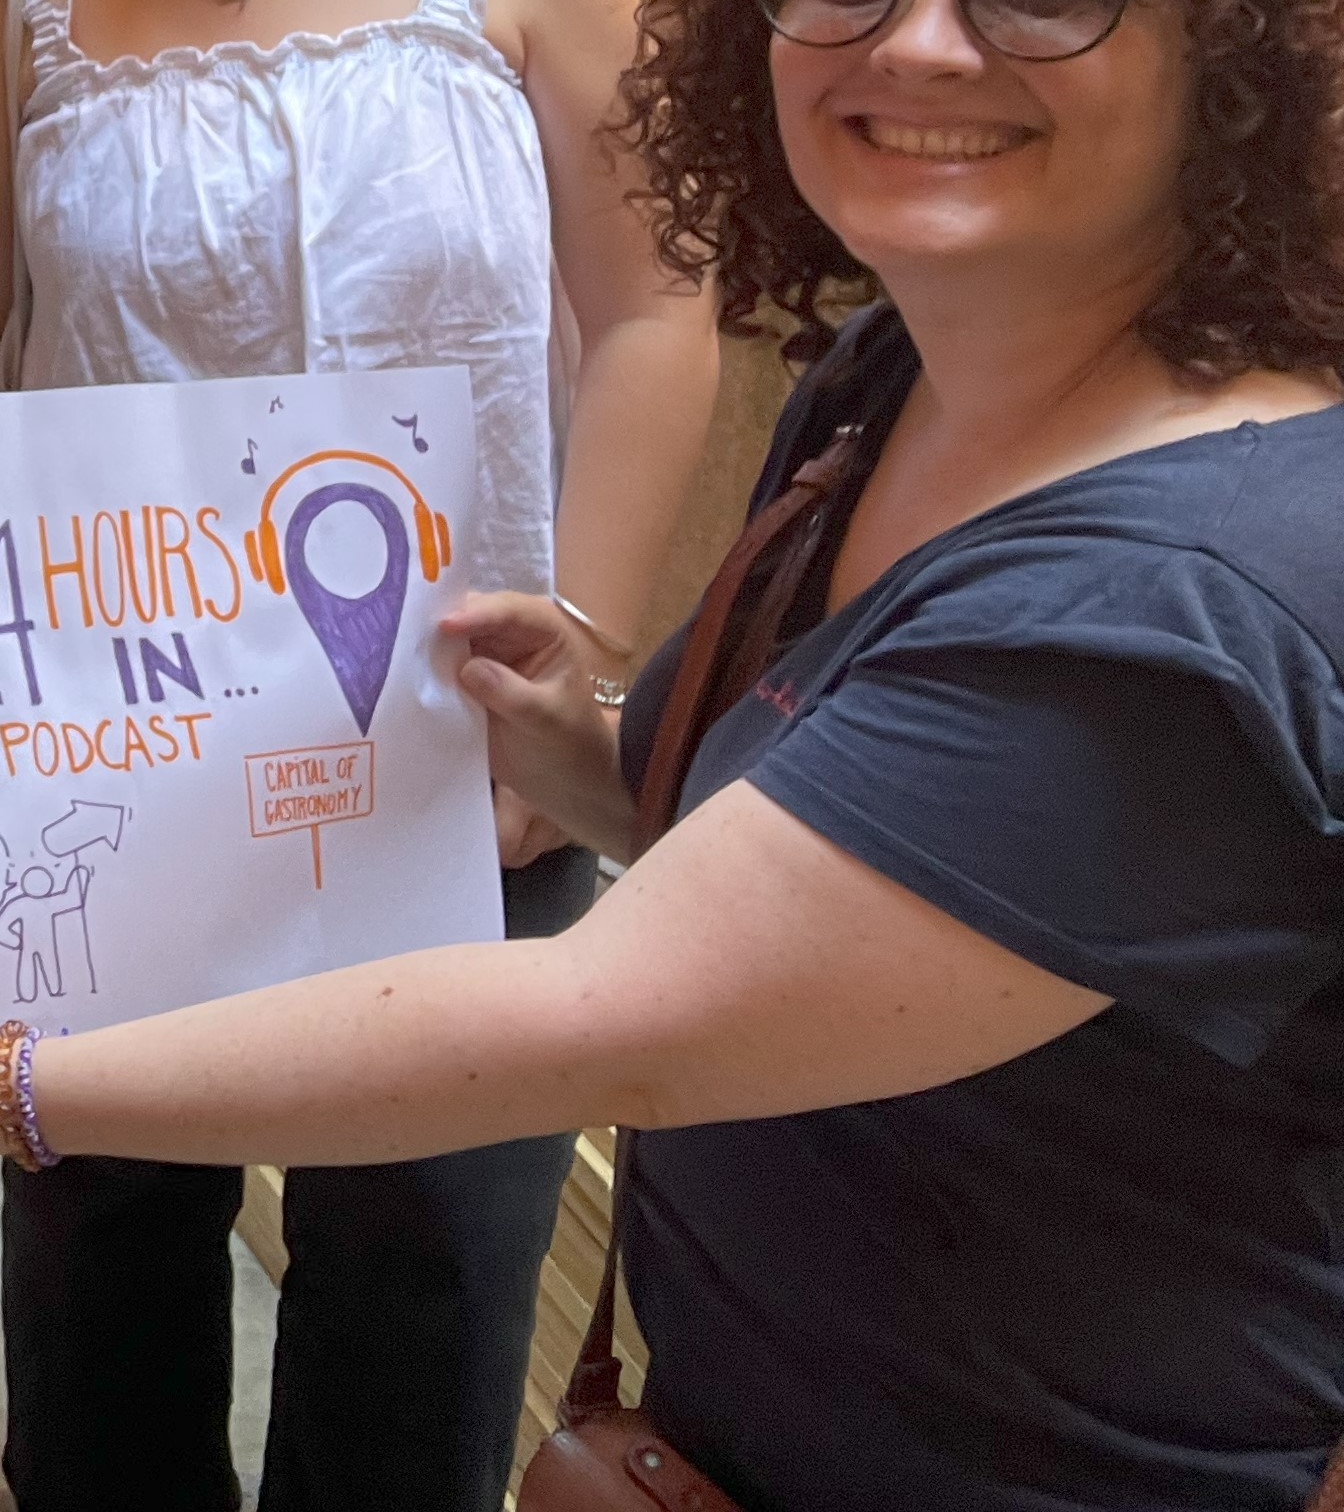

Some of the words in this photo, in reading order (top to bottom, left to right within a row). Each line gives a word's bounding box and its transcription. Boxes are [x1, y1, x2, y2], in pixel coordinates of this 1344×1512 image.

[37, 505, 243, 630] HOURS
[264, 756, 330, 792] CAPITAL
[336, 754, 359, 779] OF
[264, 784, 363, 825] GASTRONOMY
